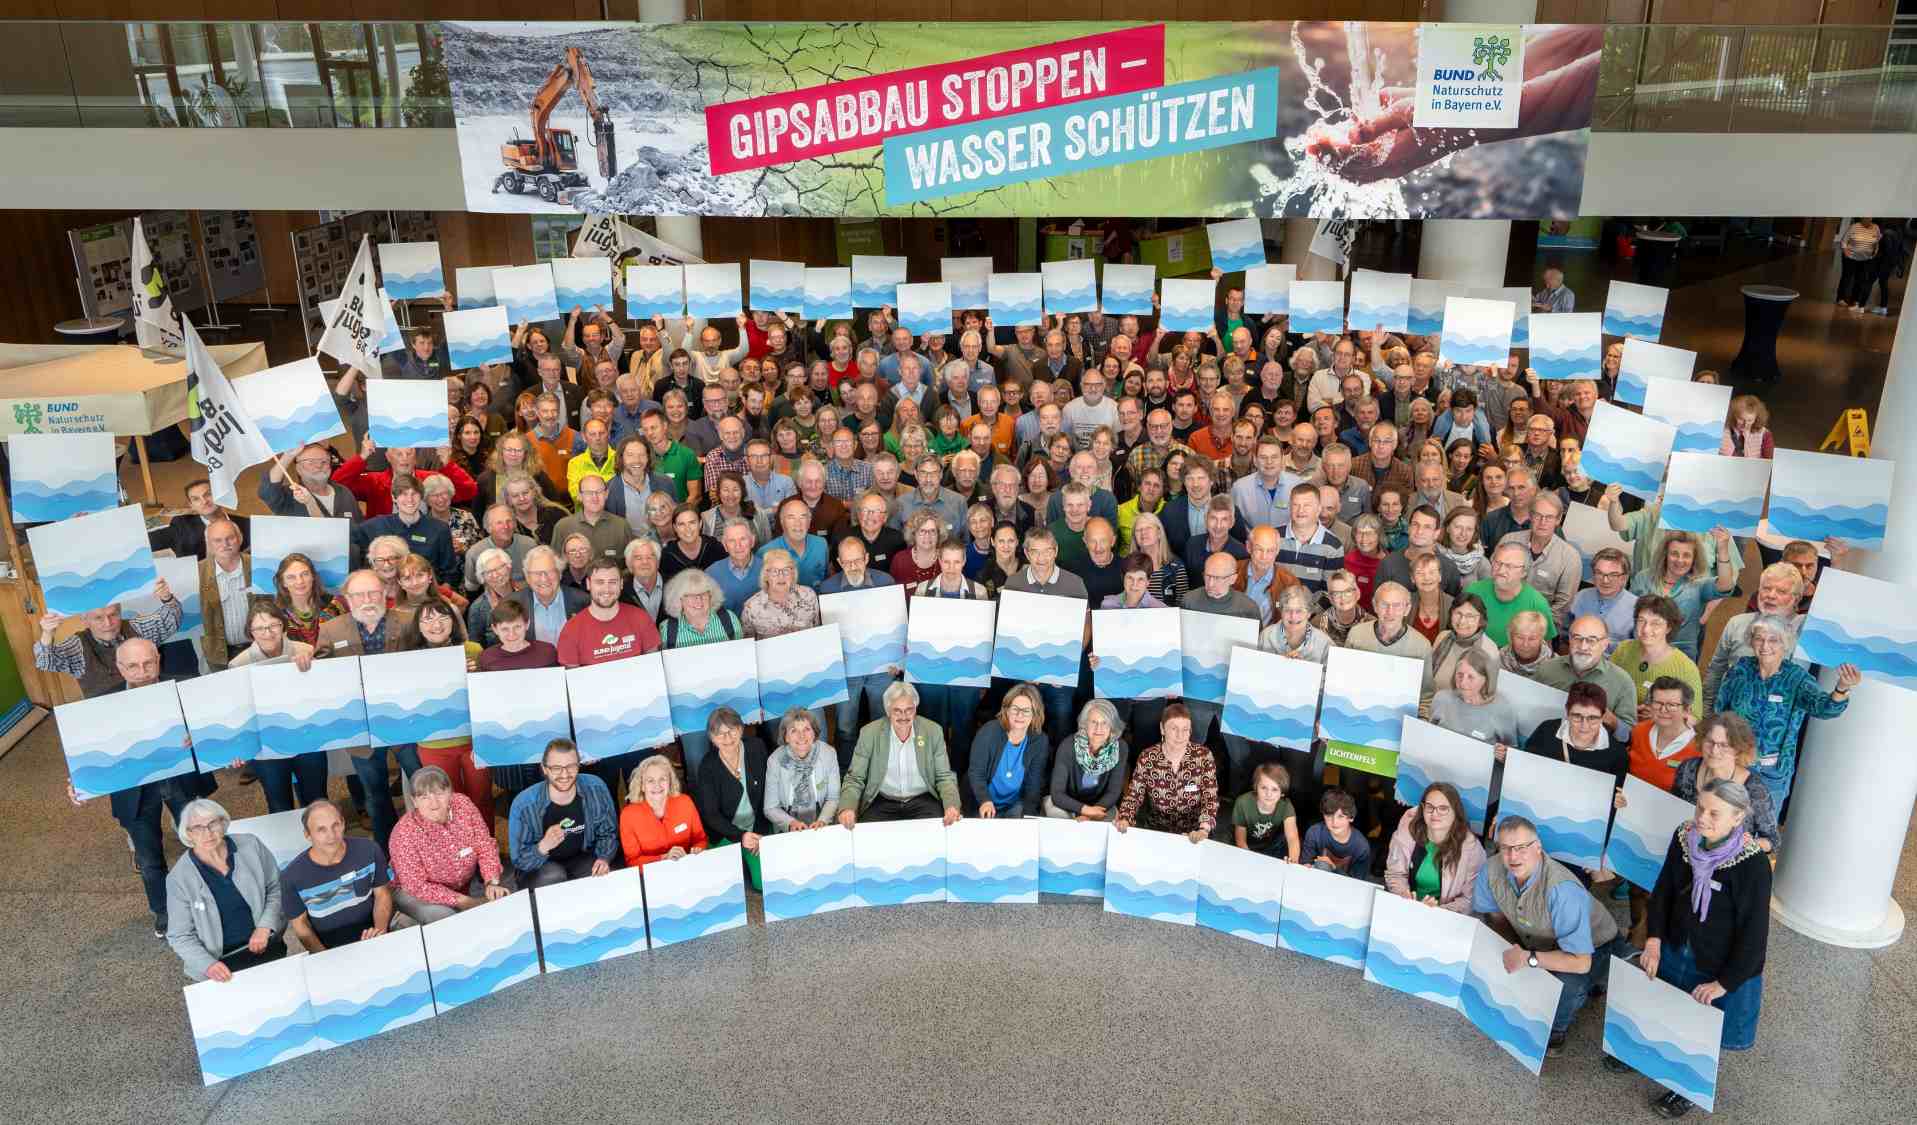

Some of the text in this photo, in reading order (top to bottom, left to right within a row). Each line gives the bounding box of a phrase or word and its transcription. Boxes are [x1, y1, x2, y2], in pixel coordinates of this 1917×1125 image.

[1433, 69, 1475, 81] BUND
[1432, 85, 1504, 96] Naturschutz
[729, 80, 929, 160] GIPSABBAU
[942, 47, 1107, 120] STOPPEN
[1431, 99, 1502, 112] in Bayern e.V.
[905, 84, 1256, 190] WASSER SCHÜTZEN
[47, 402, 79, 412] BUND
[48, 414, 105, 425] Naturschutz
[1329, 747, 1377, 765] LICHTENFELS
